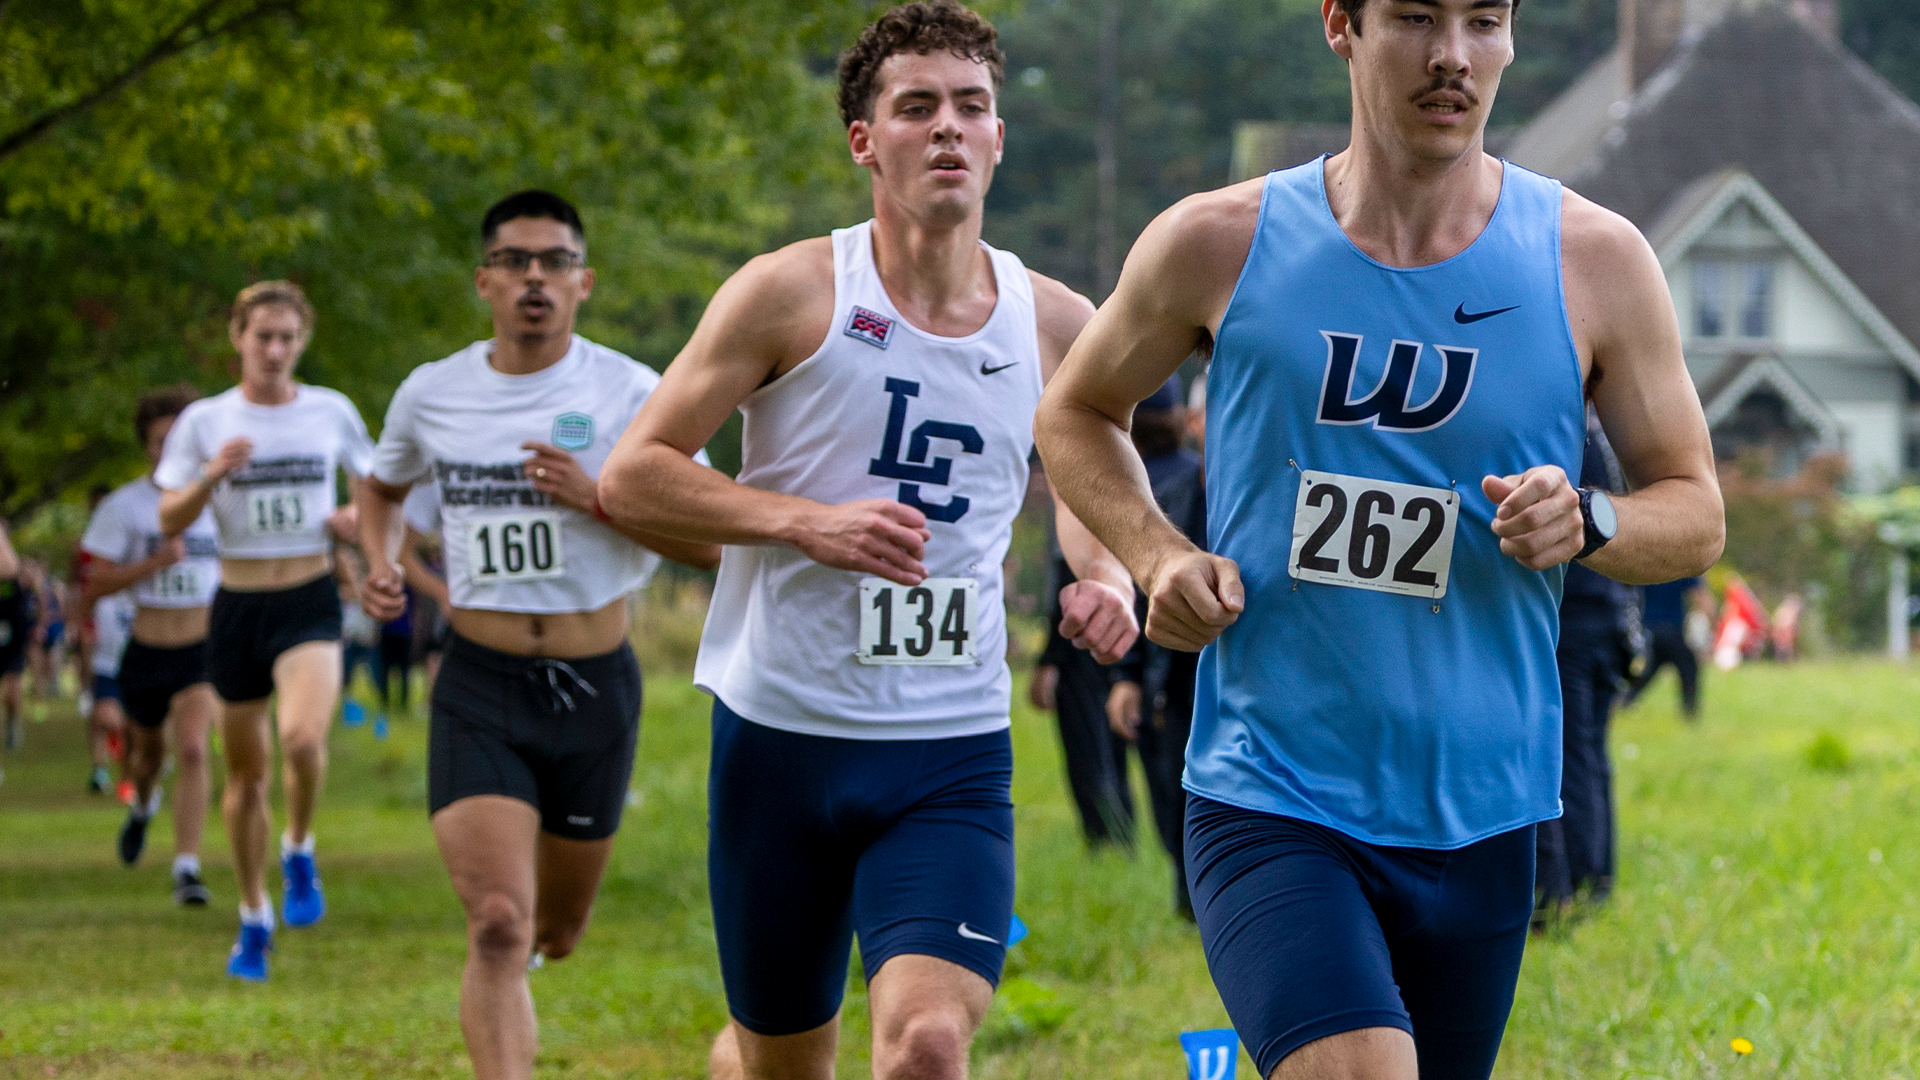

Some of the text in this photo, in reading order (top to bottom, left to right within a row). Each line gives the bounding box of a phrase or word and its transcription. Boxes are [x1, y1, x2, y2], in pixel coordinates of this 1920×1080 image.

[1315, 330, 1479, 433] W
[476, 520, 553, 574] 160
[1299, 483, 1446, 587] 262
[872, 586, 968, 657] 134
